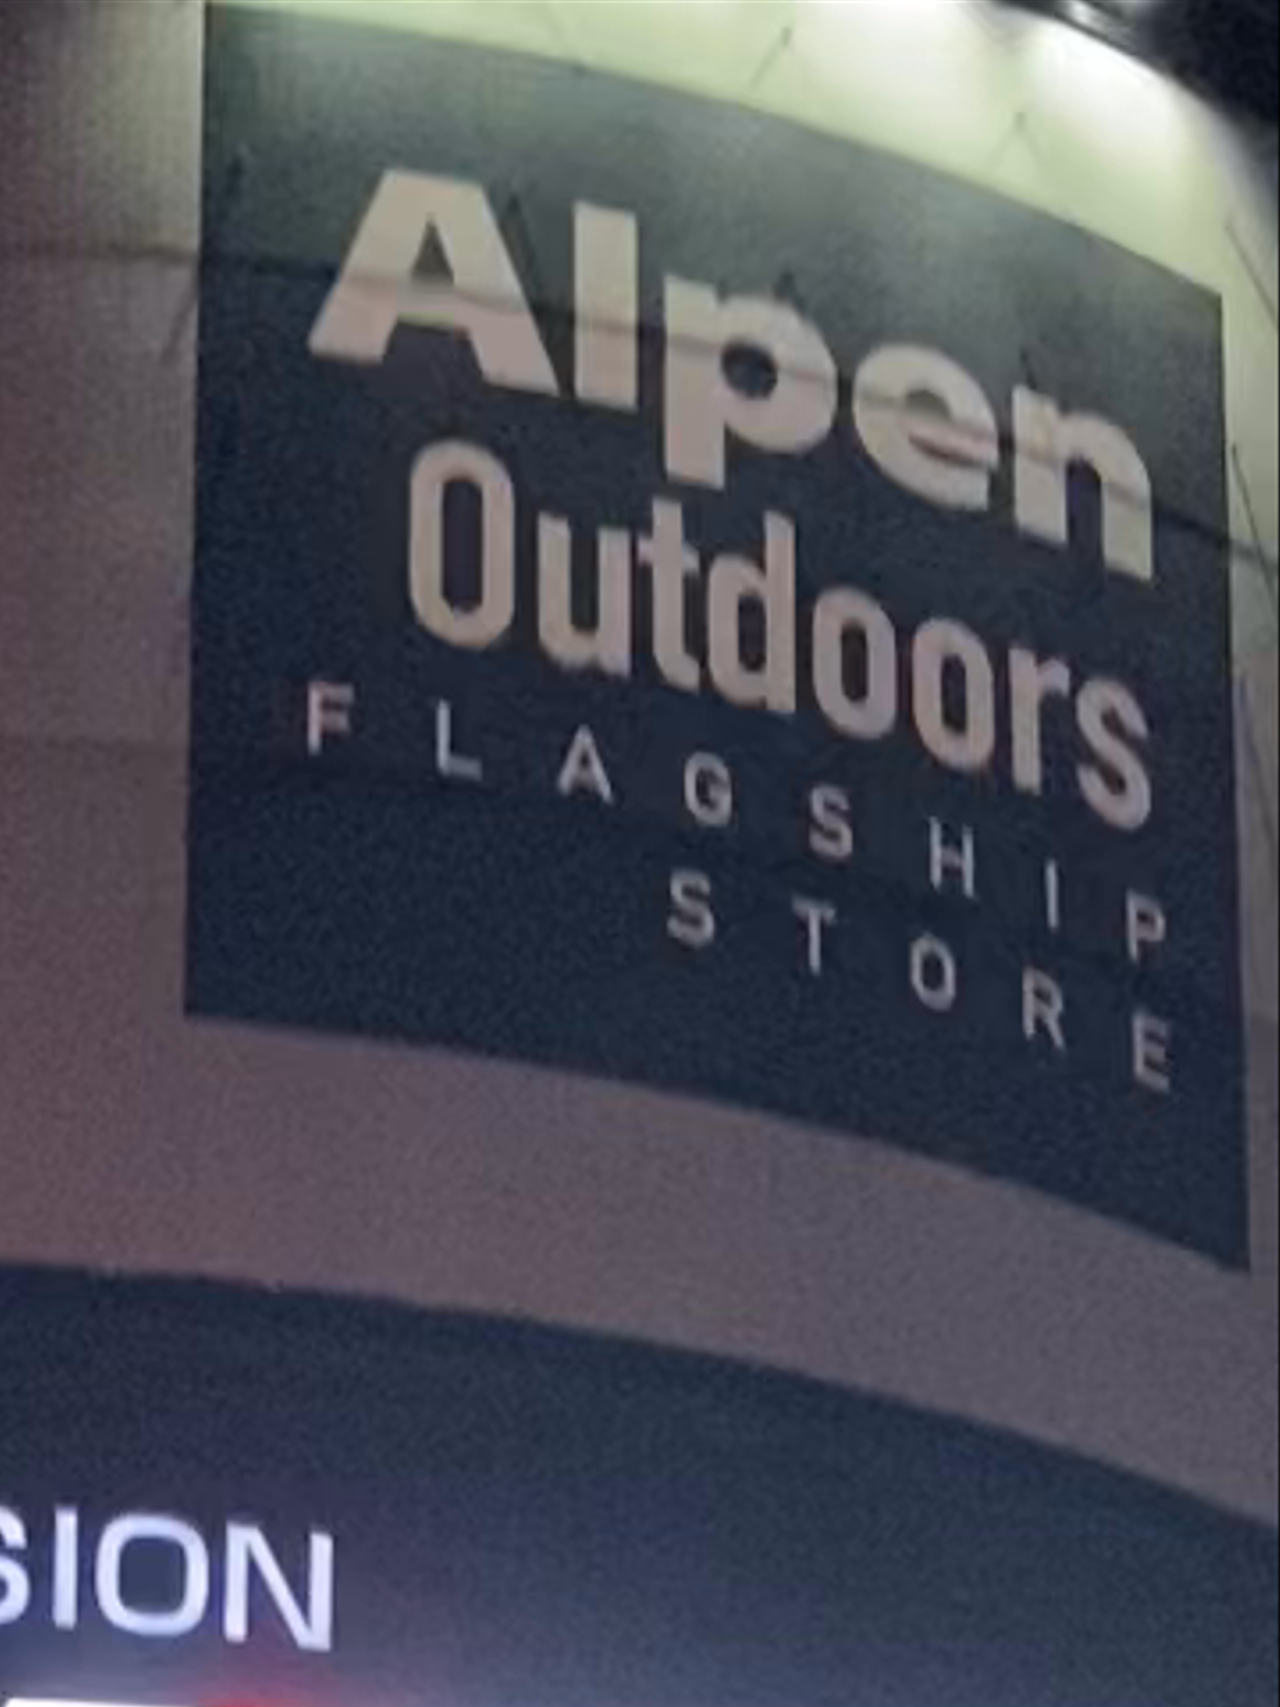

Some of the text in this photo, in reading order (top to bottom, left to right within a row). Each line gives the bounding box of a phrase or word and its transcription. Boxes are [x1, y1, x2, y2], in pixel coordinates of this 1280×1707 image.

[306, 167, 1153, 583] Alpen
[406, 438, 1152, 831] Outdoors
[306, 679, 1166, 966] FLAGSHIP
[666, 868, 1171, 1091] STORE
